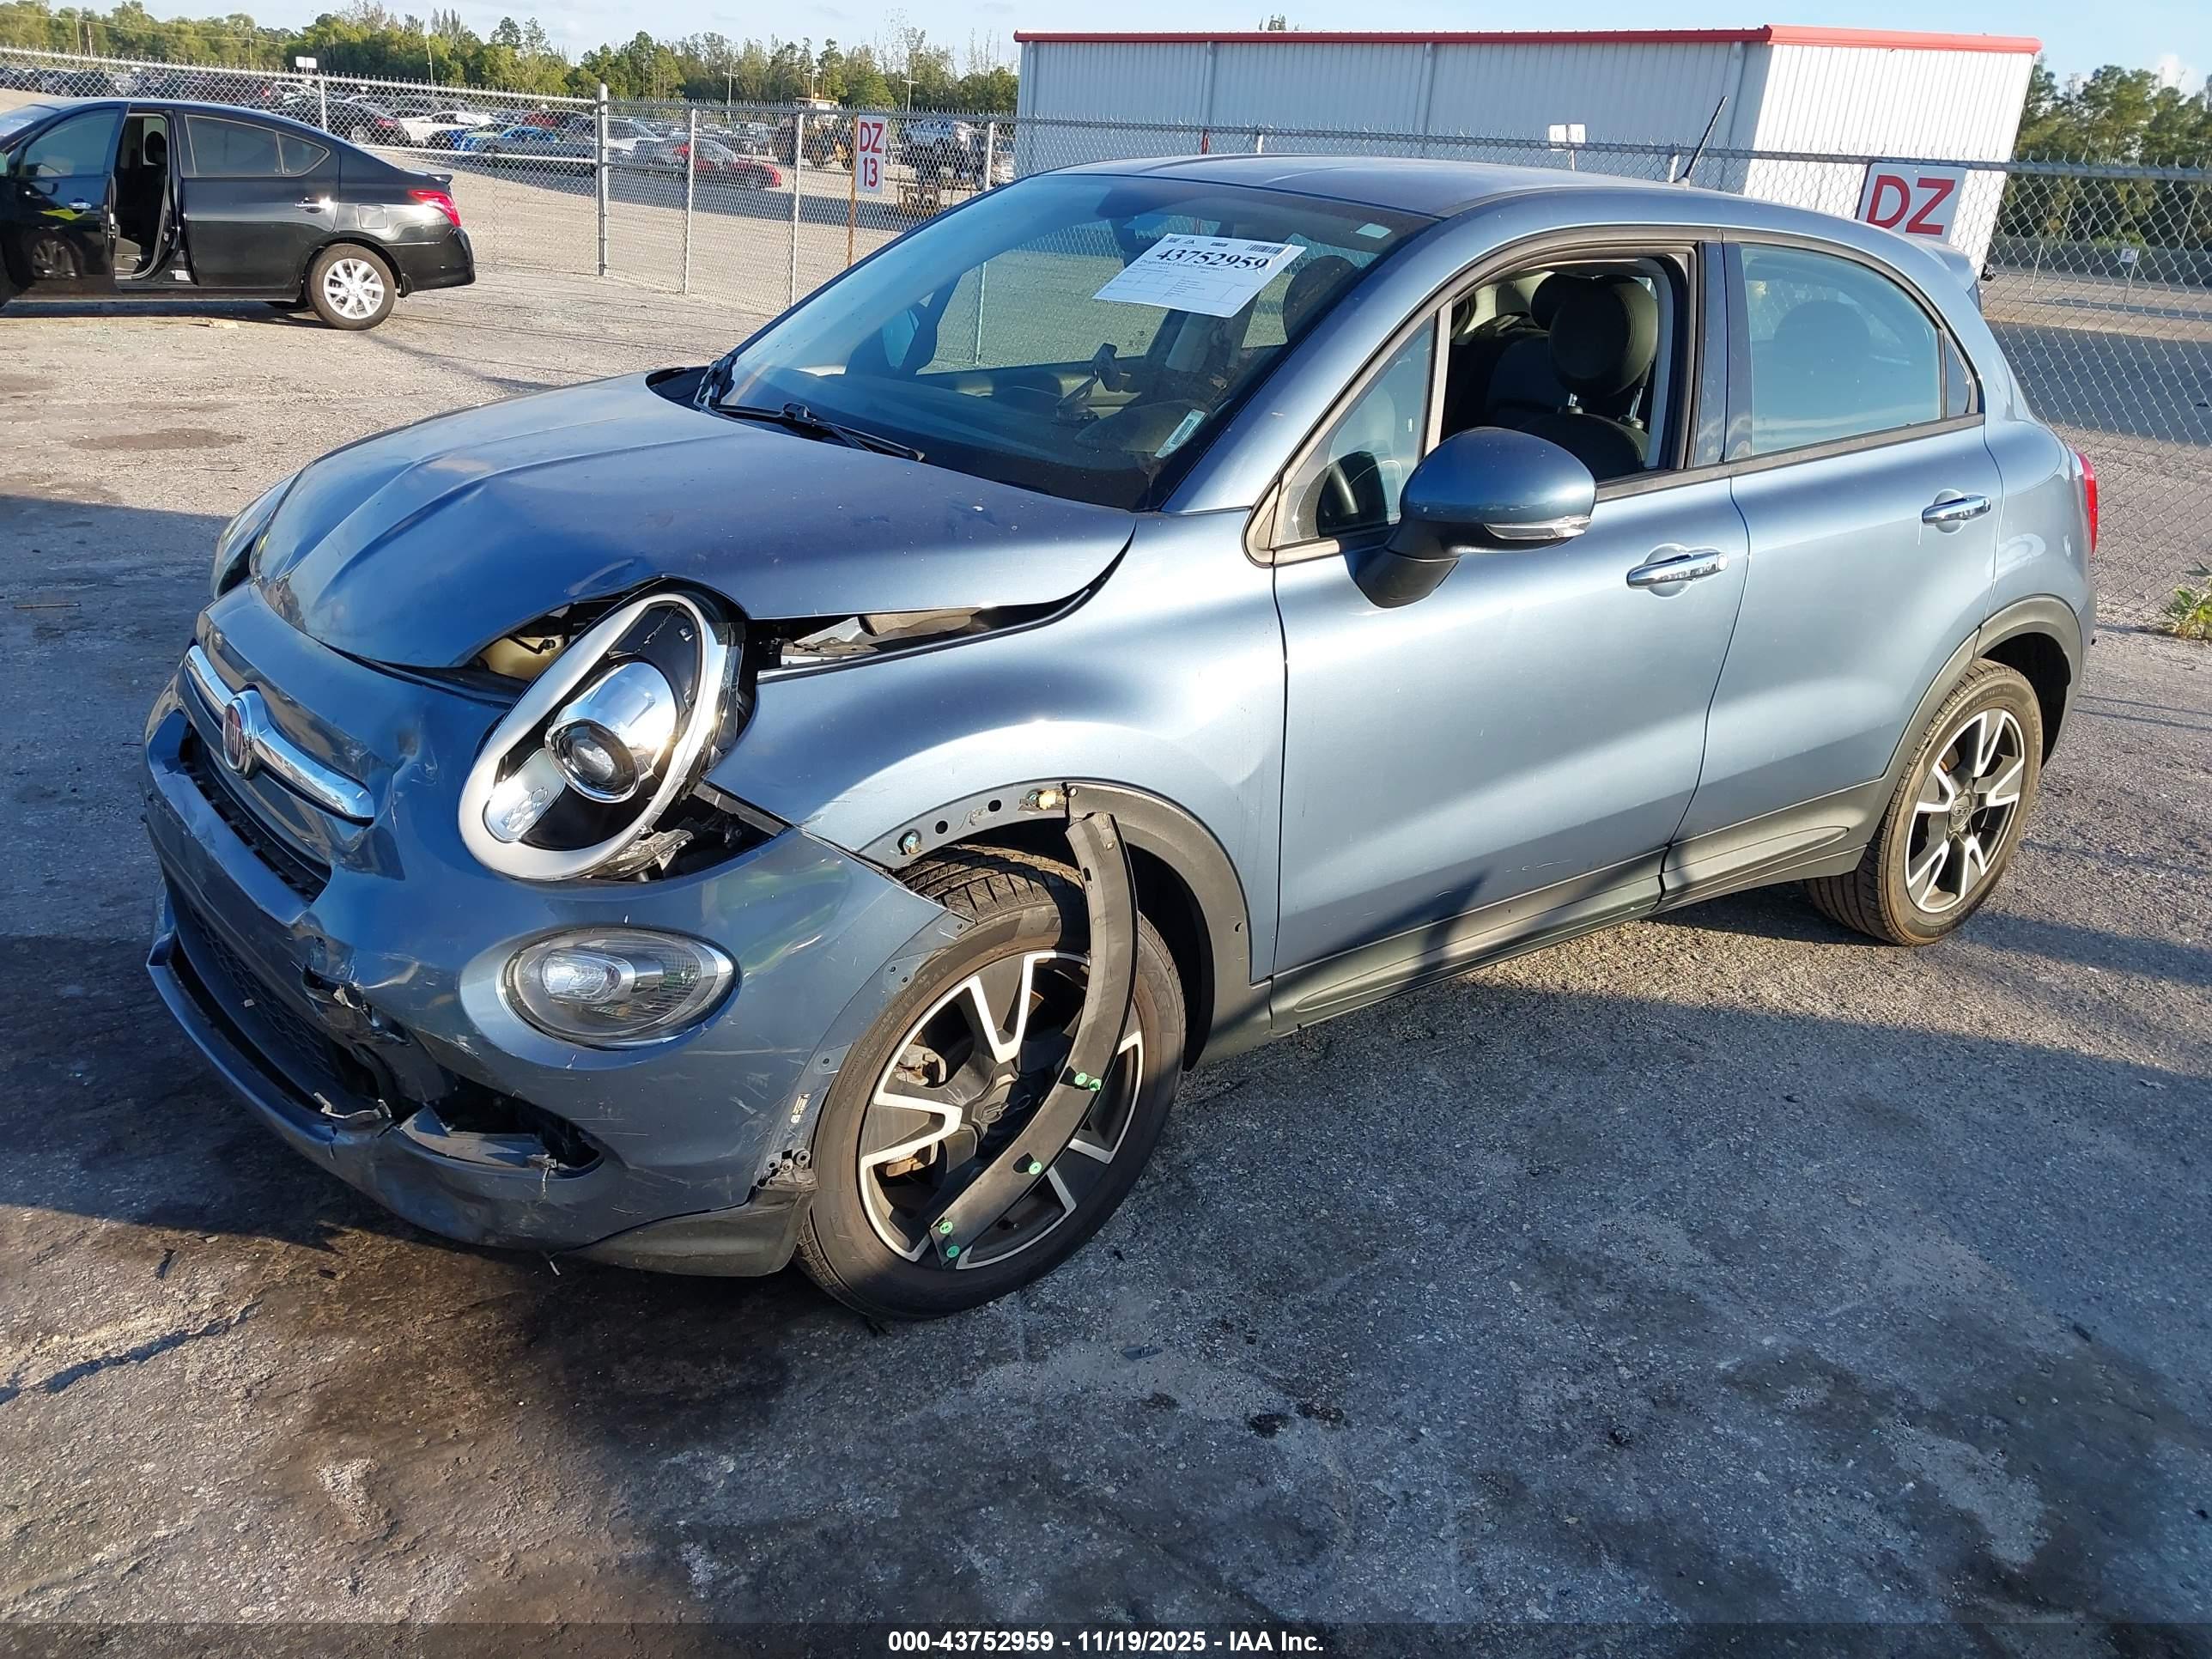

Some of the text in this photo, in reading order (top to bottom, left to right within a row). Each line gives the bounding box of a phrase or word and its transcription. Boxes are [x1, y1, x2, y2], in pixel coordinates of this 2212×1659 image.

[860, 122, 883, 153] DZ
[863, 157, 878, 187] 13
[1866, 174, 1955, 235] DZ
[1156, 248, 1269, 270] 43752959
